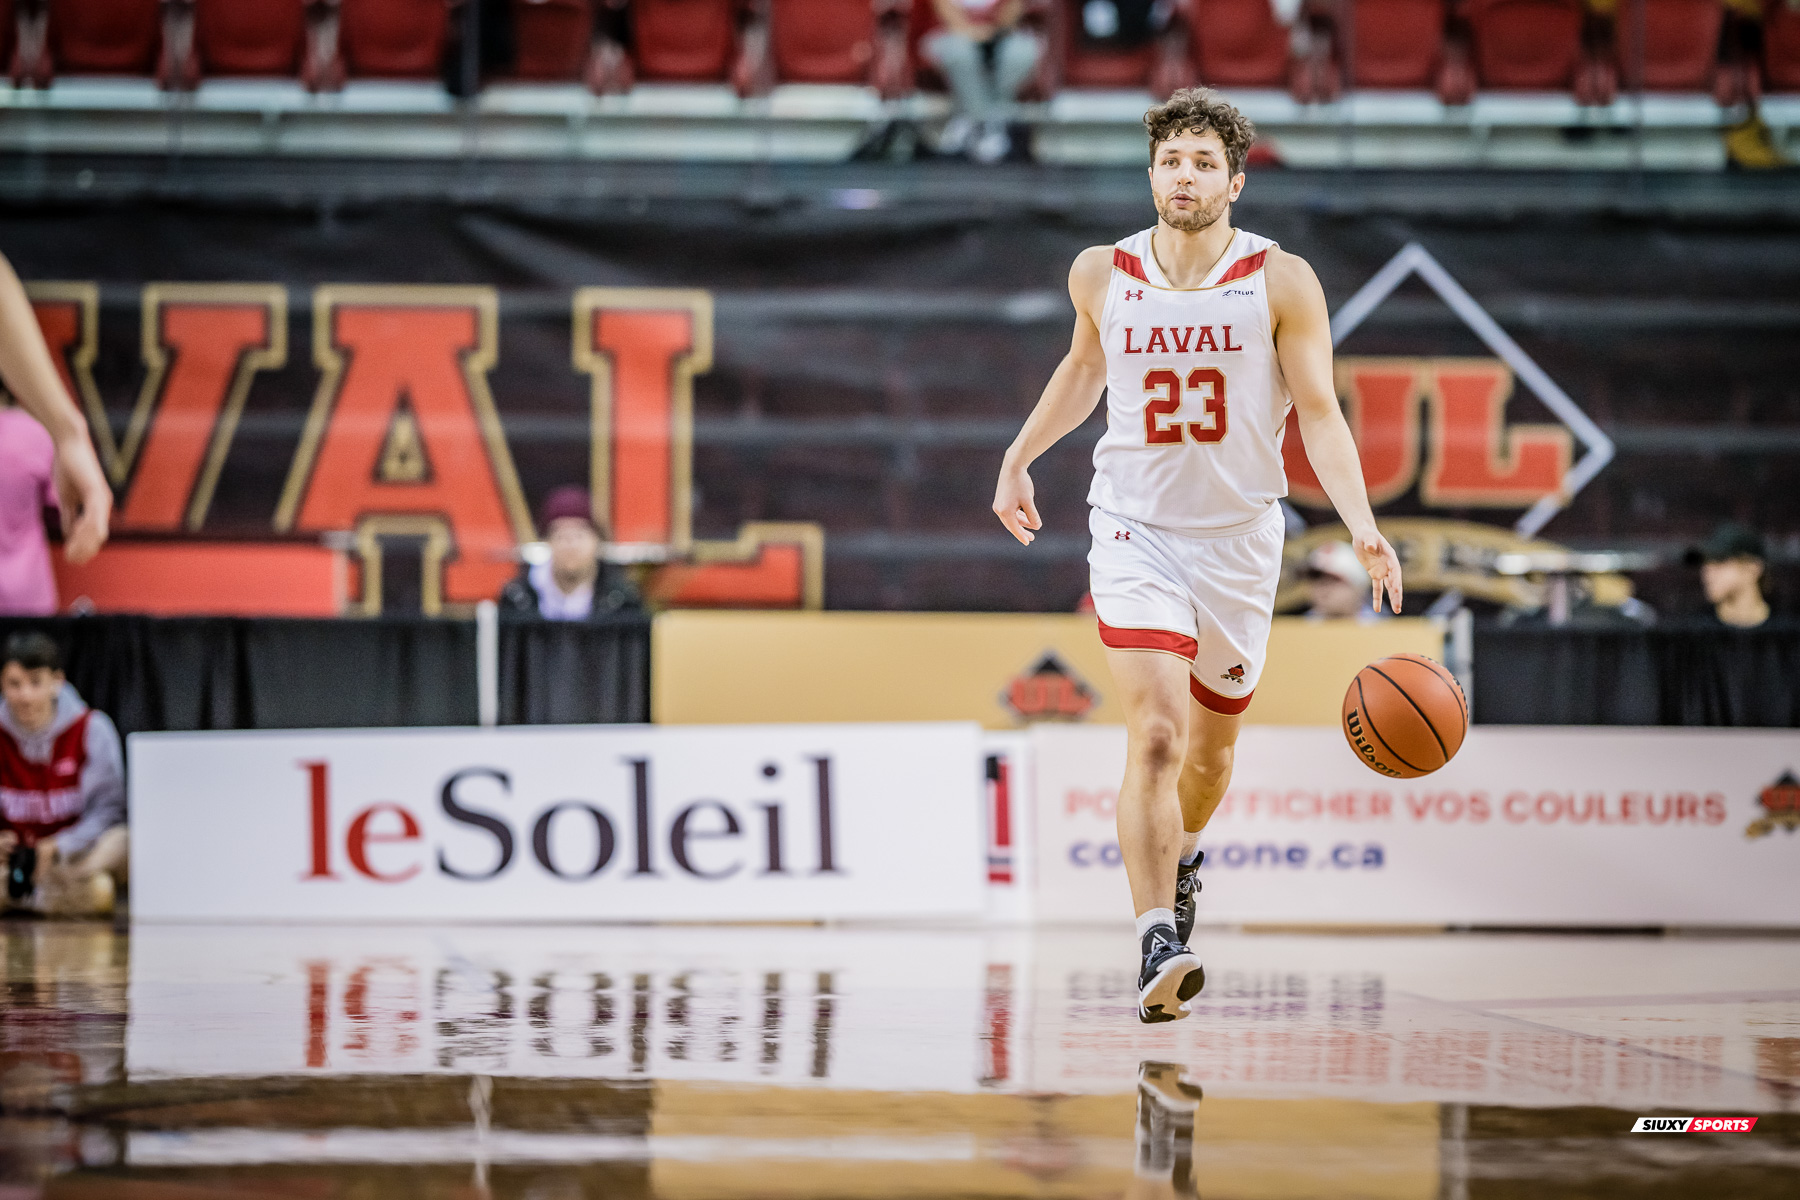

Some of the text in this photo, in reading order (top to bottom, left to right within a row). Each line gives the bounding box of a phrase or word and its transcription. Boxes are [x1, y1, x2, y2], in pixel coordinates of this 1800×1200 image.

[1123, 324, 1243, 355] LAVAL
[1142, 366, 1229, 446] 23
[1346, 707, 1402, 778] Wilson
[294, 752, 850, 884] leSoleil
[1212, 789, 1394, 822] FFICHER
[1403, 789, 1492, 824] VOS
[1500, 790, 1728, 826] COULEURS
